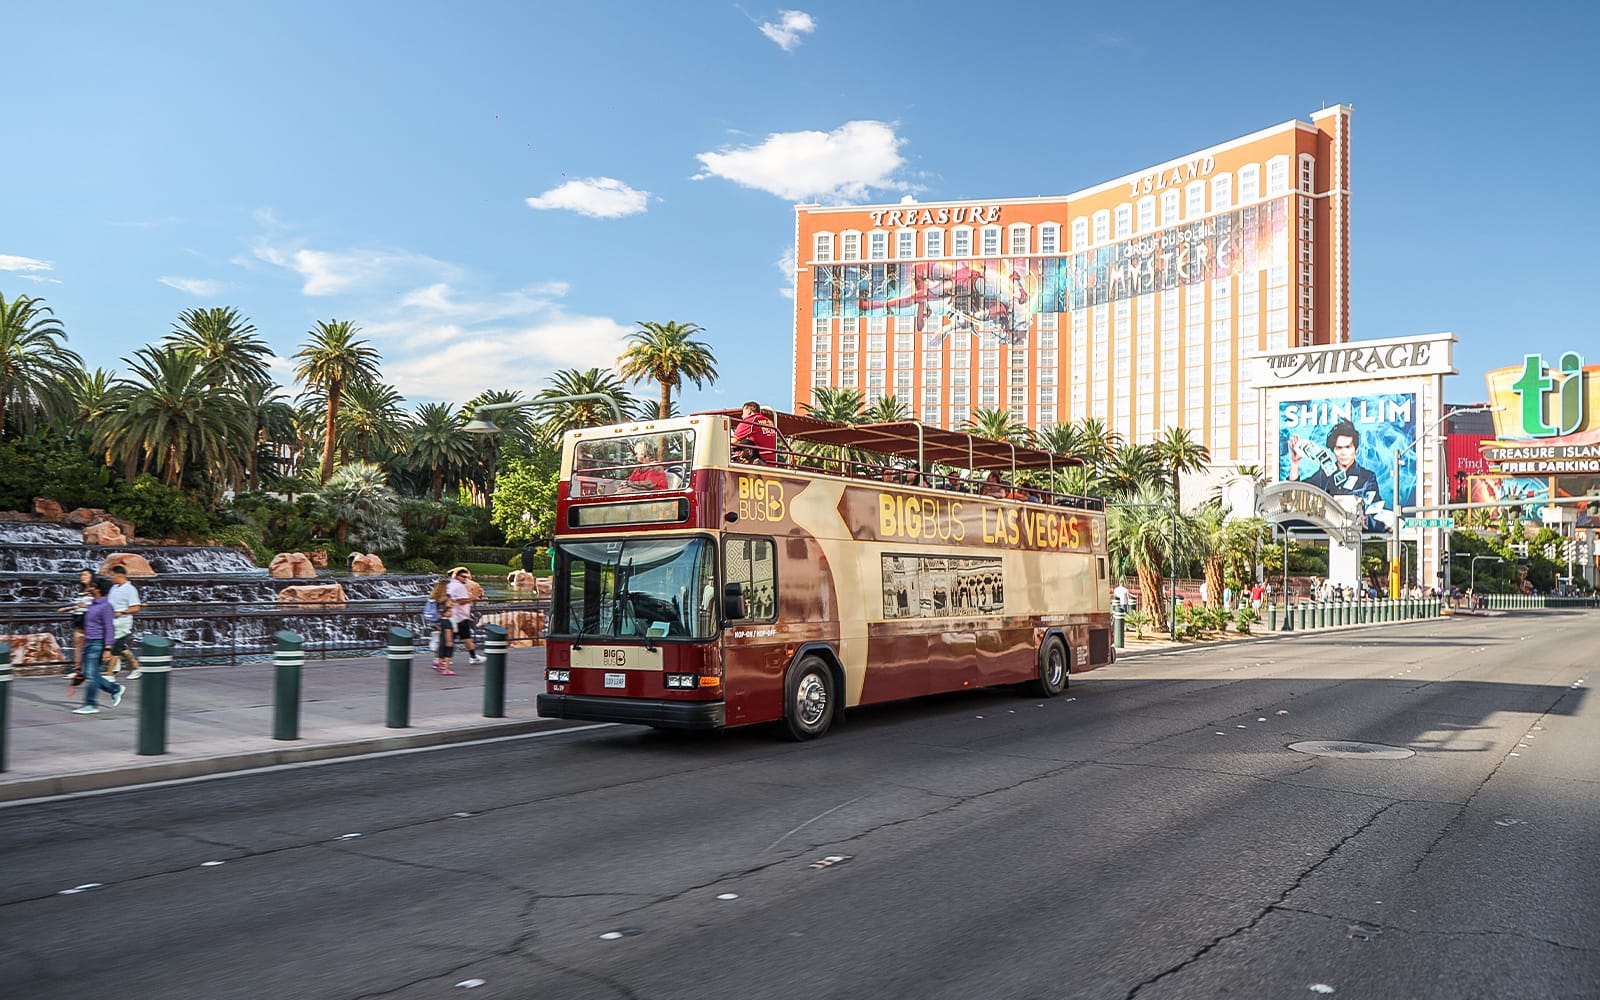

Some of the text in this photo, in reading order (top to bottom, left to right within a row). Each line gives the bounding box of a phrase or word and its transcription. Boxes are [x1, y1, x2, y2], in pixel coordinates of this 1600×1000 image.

[1129, 155, 1216, 198] ISLAND
[869, 205, 1002, 228] TREASURE
[1161, 232, 1176, 250] DU
[1266, 341, 1431, 379] THE MIRAGE
[1283, 397, 1412, 428] SHIN LIM
[1457, 457, 1483, 469] Find
[1491, 447, 1555, 459] TREASURE
[1502, 463, 1535, 473] FREE
[1539, 460, 1600, 471] PARKING
[738, 476, 765, 501] BIG
[739, 499, 766, 521] BUS
[981, 506, 1020, 545] LAS
[1023, 506, 1080, 549] VEGAS
[603, 649, 616, 658] BIG
